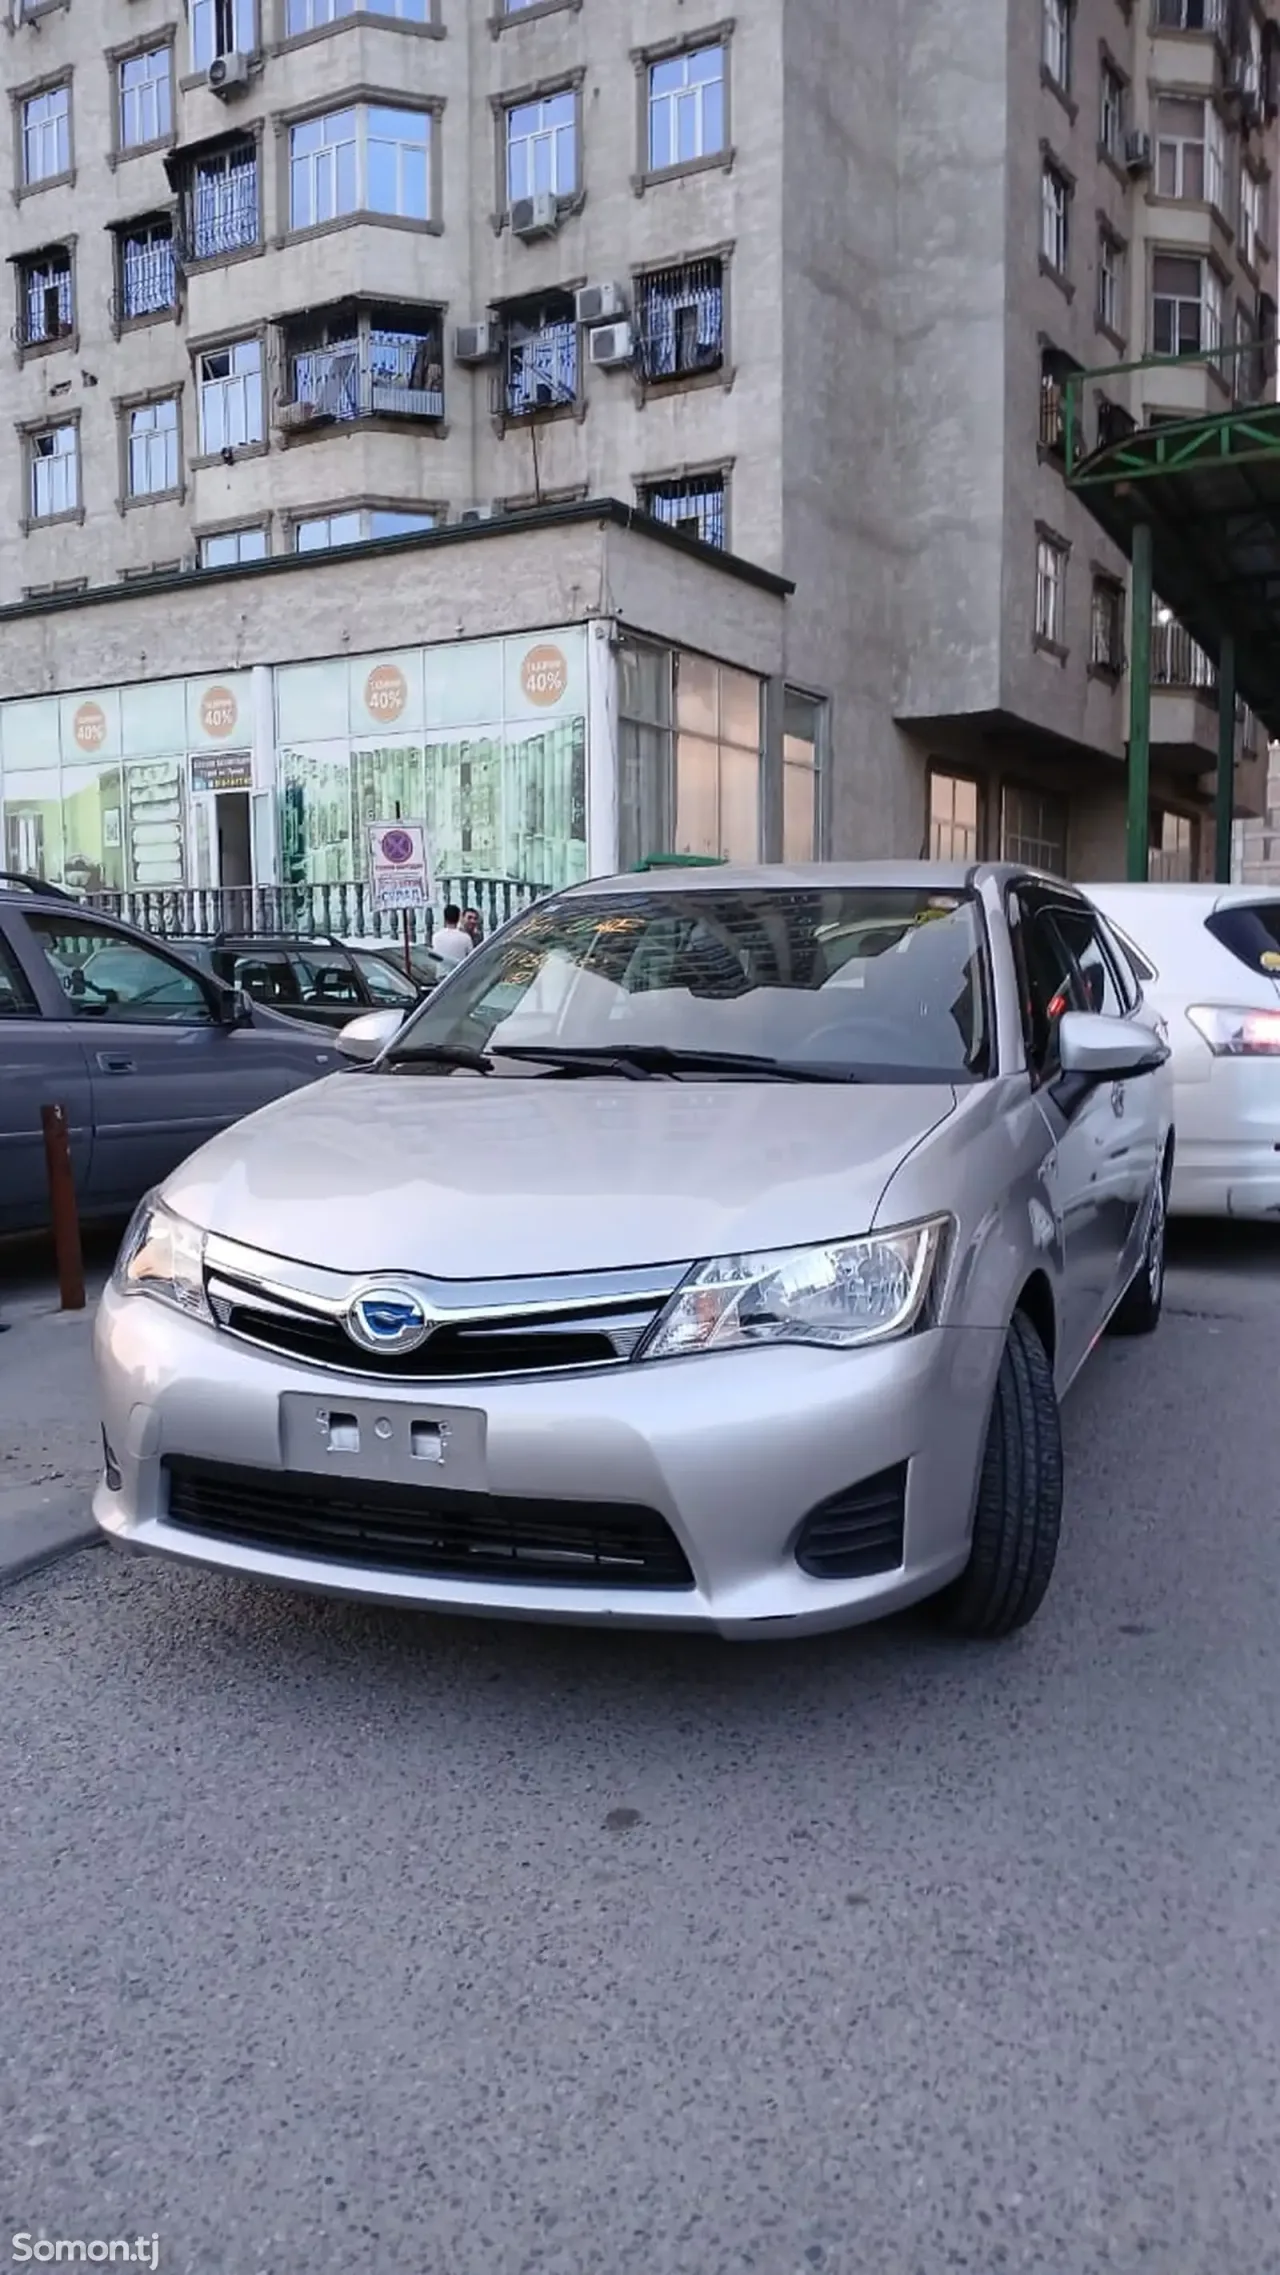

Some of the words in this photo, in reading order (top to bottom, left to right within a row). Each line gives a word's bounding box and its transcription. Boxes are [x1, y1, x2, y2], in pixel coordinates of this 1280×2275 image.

[527, 671, 562, 692] 40%
[370, 689, 402, 709] 40%
[204, 709, 233, 726] 40%
[77, 725, 102, 740] 40%
